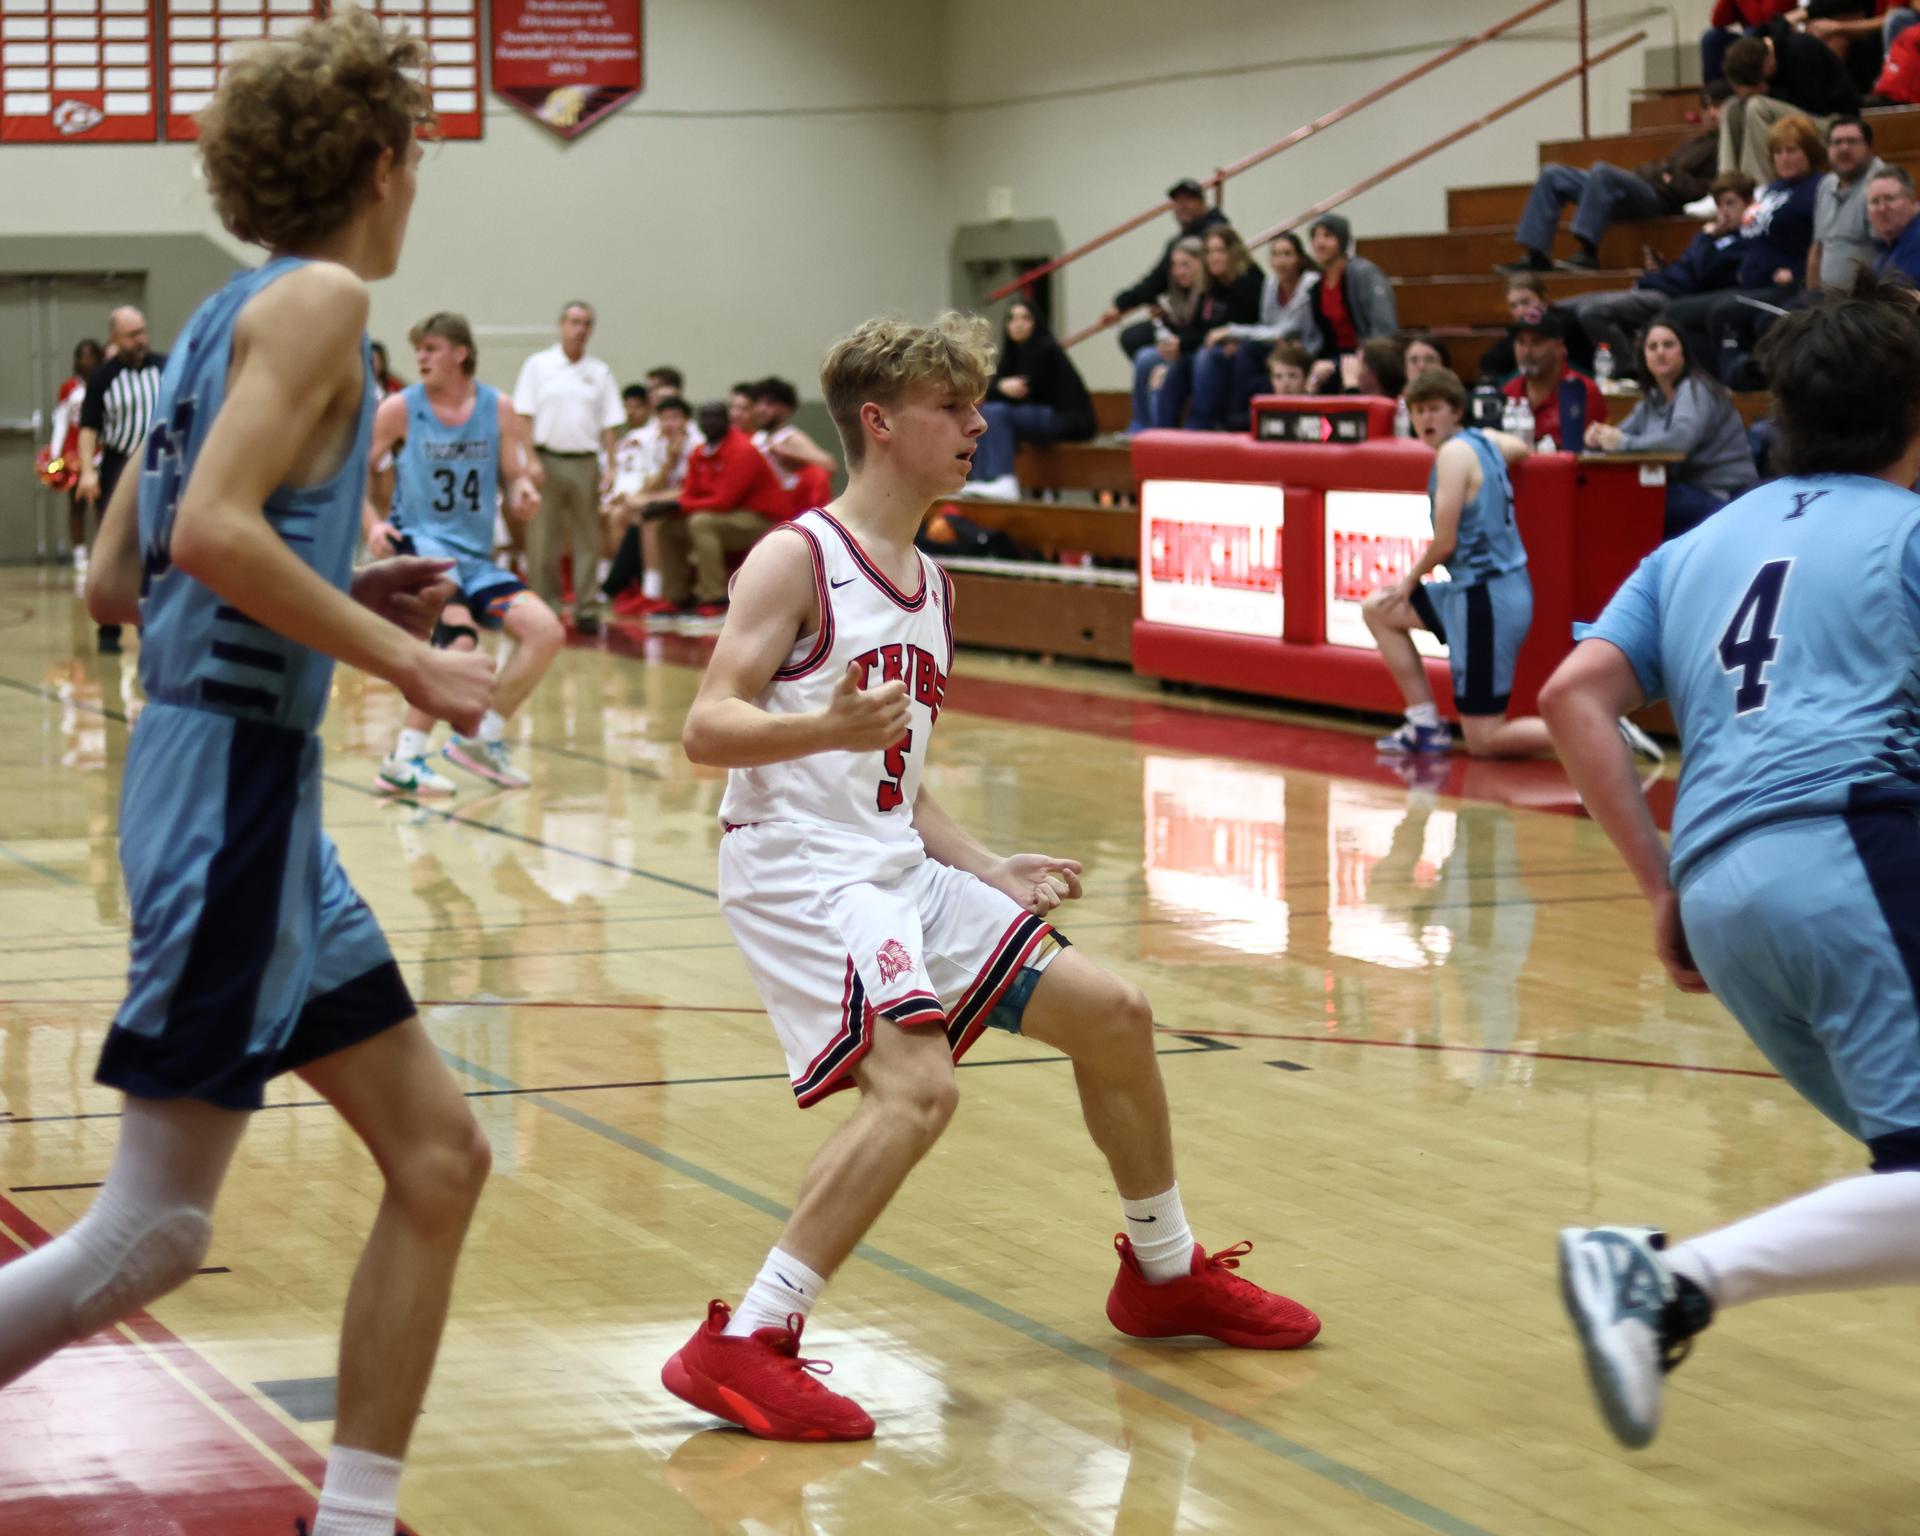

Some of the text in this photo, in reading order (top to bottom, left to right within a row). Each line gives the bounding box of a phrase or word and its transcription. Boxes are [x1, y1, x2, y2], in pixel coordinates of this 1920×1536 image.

[432, 468, 480, 513] 34
[1782, 489, 1834, 521] Y
[1717, 556, 1797, 719] 4
[876, 728, 913, 813] 5
